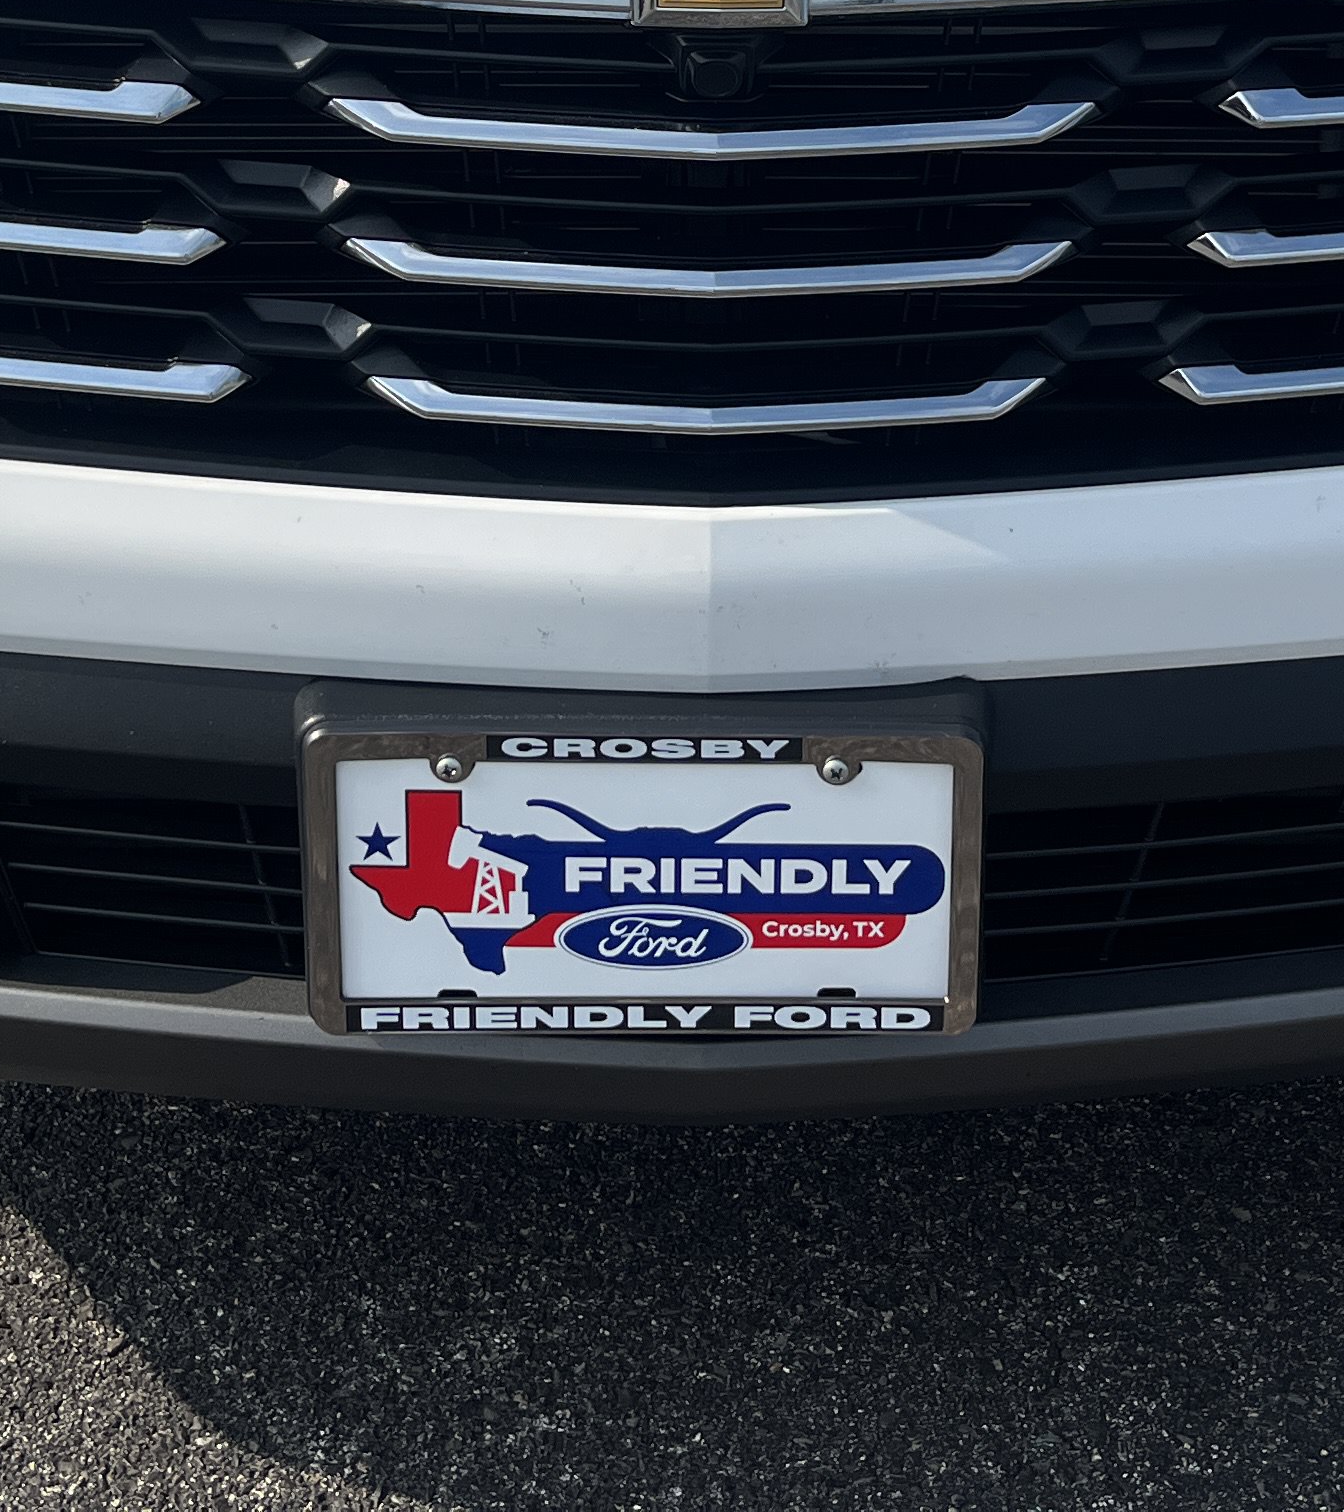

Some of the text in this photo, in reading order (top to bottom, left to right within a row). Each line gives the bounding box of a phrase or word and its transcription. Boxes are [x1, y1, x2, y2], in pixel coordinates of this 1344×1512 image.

[501, 737, 790, 760] CROSBY
[564, 856, 912, 895] FRIENDLY
[598, 916, 710, 958] Ford
[761, 920, 885, 941] Crosby, TX
[360, 1006, 932, 1031] FRIENDLY FORD
